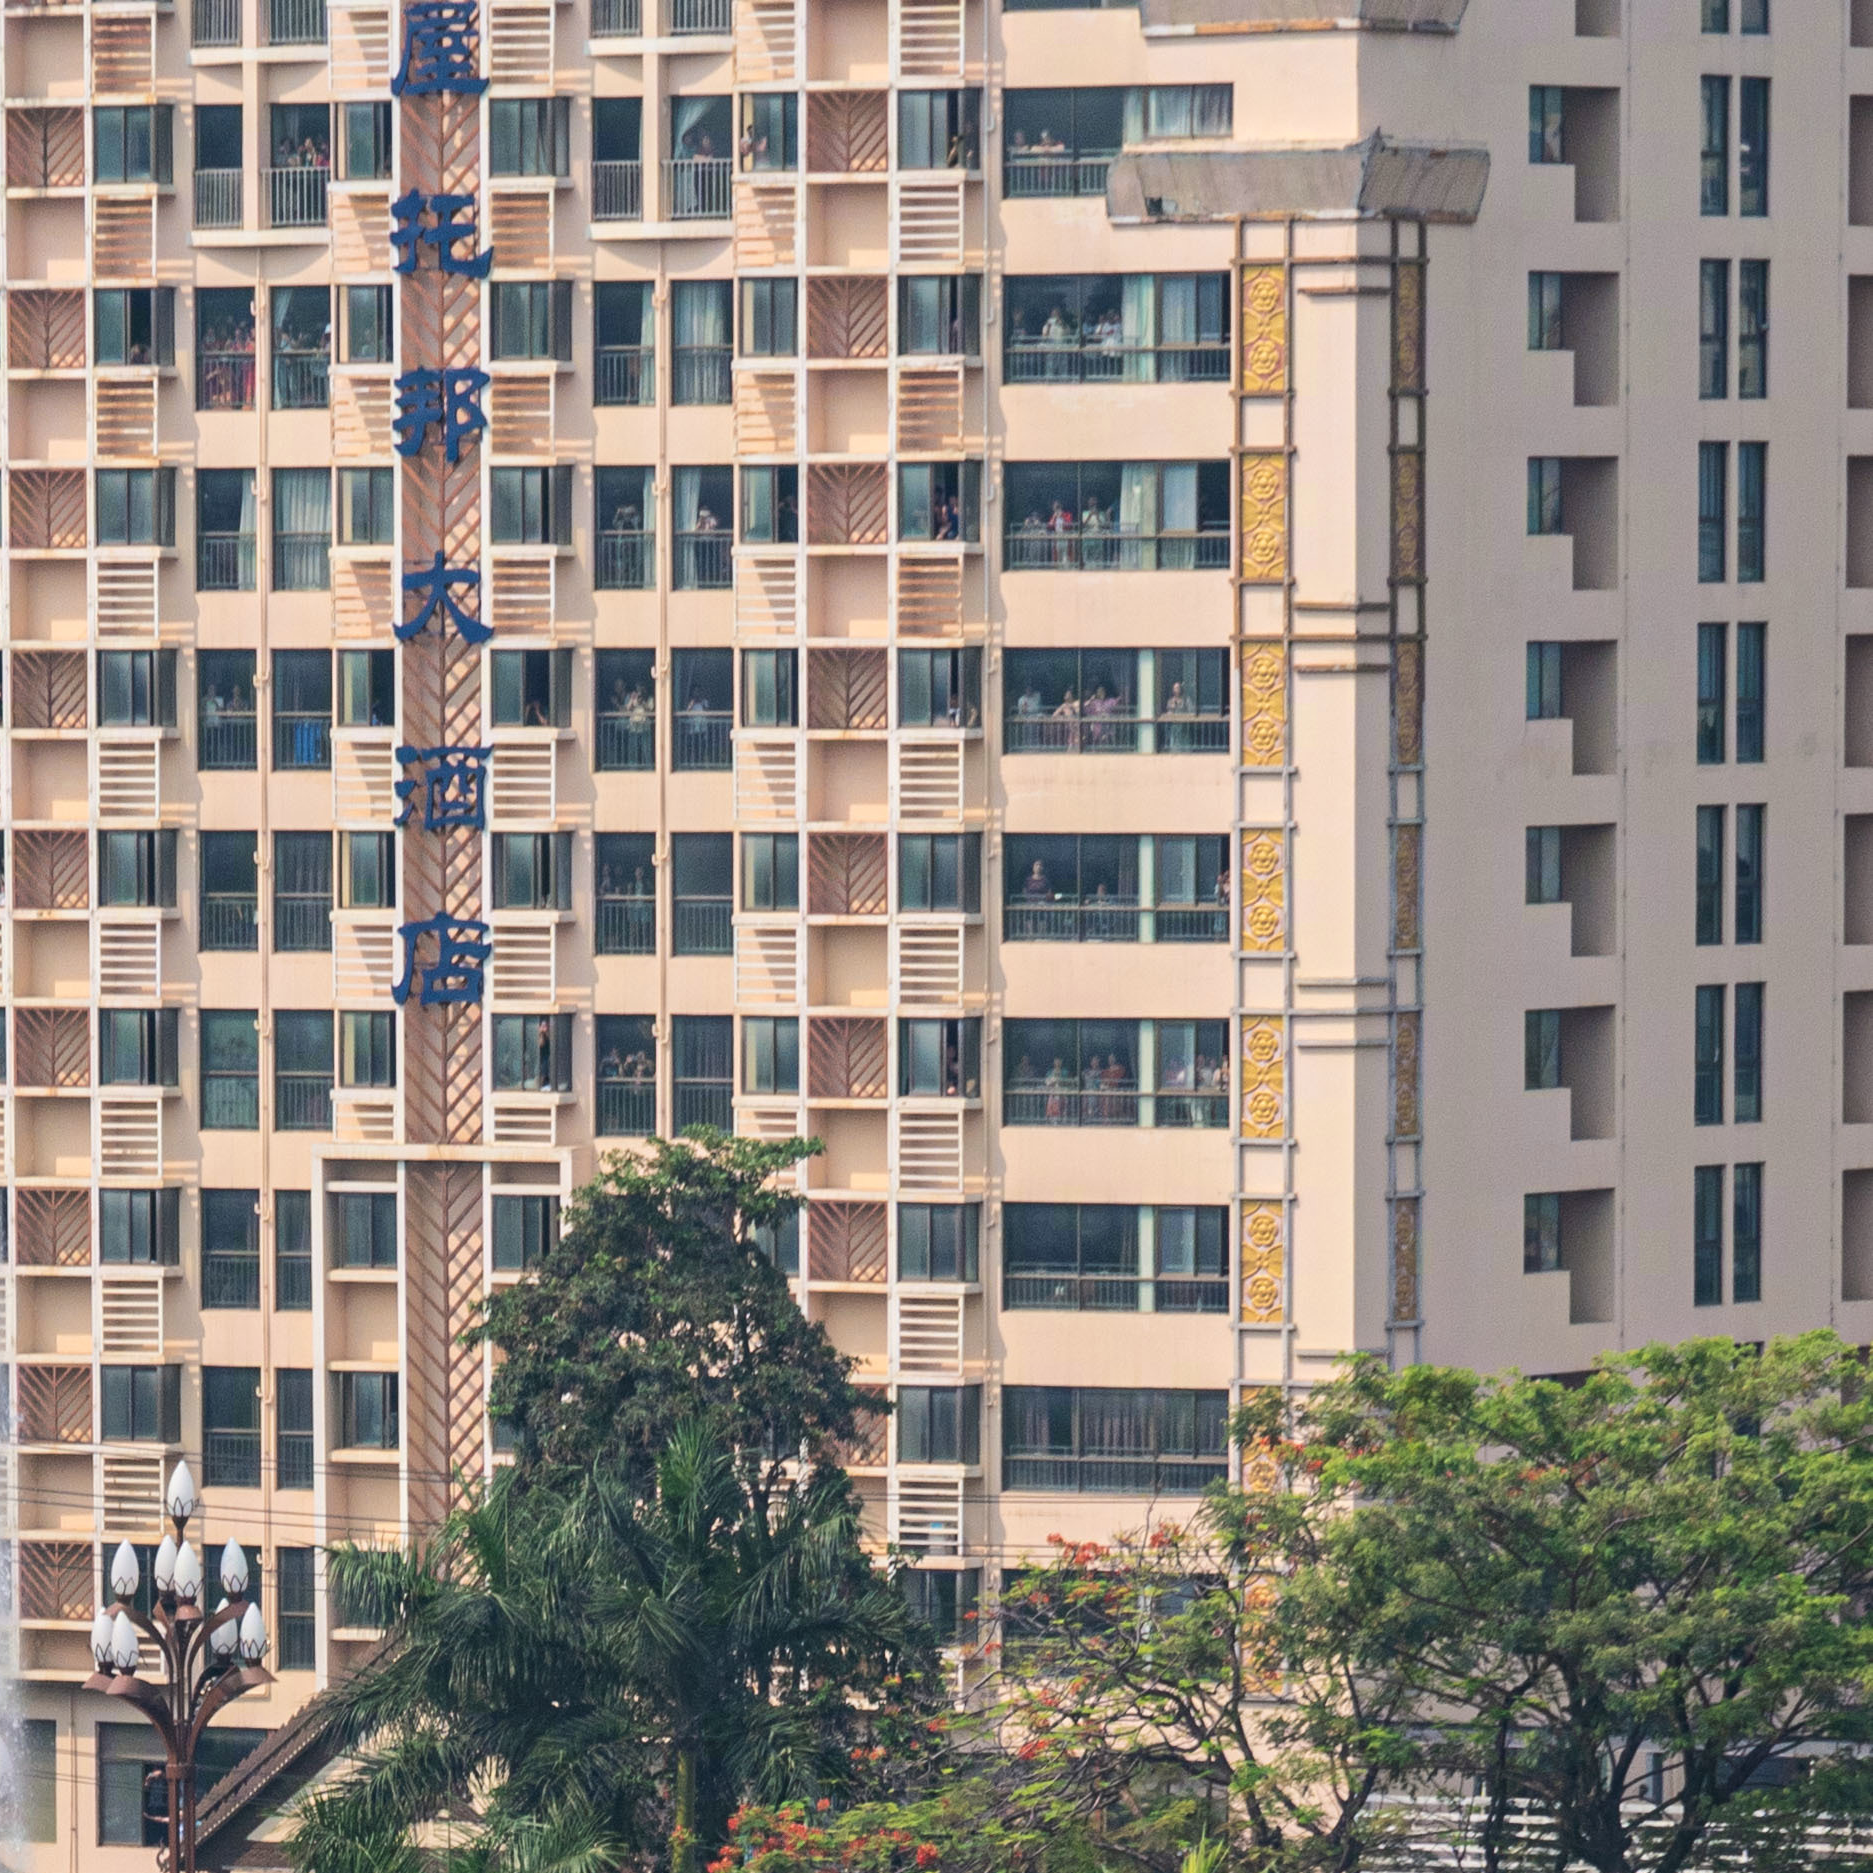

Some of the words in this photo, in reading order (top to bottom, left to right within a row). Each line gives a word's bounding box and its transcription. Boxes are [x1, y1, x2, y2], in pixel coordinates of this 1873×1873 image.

[390, 2, 495, 1006] 屋托邦大酒店
